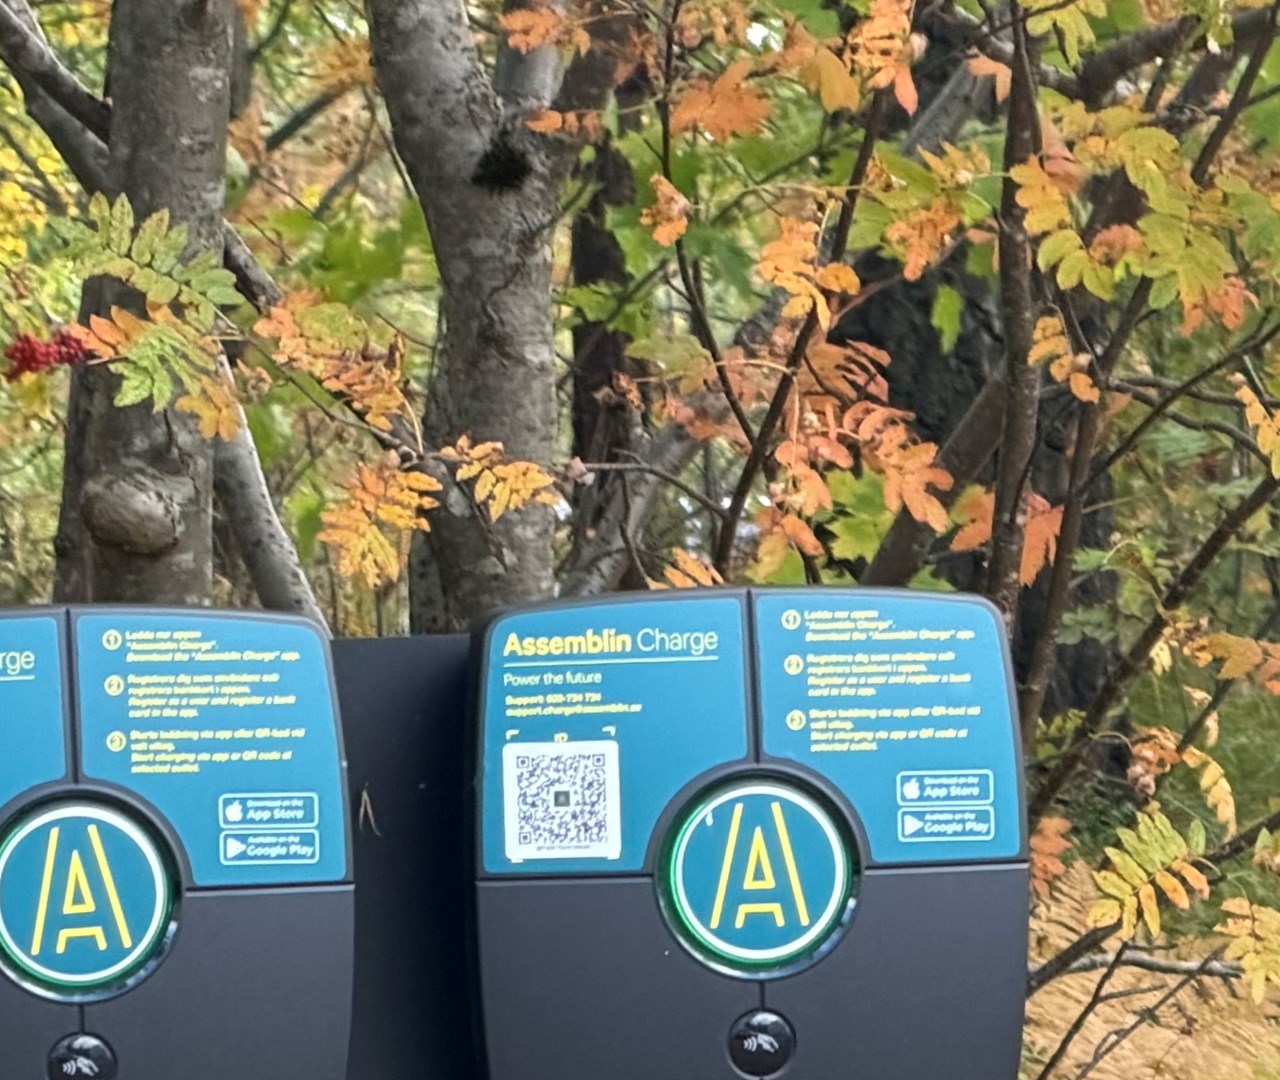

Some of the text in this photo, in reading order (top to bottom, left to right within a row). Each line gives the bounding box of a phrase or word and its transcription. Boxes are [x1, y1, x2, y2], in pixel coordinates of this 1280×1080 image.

[503, 628, 719, 657] Assemblin Charge
[503, 671, 602, 686] Power the future
[923, 785, 980, 798] App Store
[246, 808, 304, 821] App Store
[924, 821, 989, 834] Google Play
[246, 845, 315, 858] Google Play
